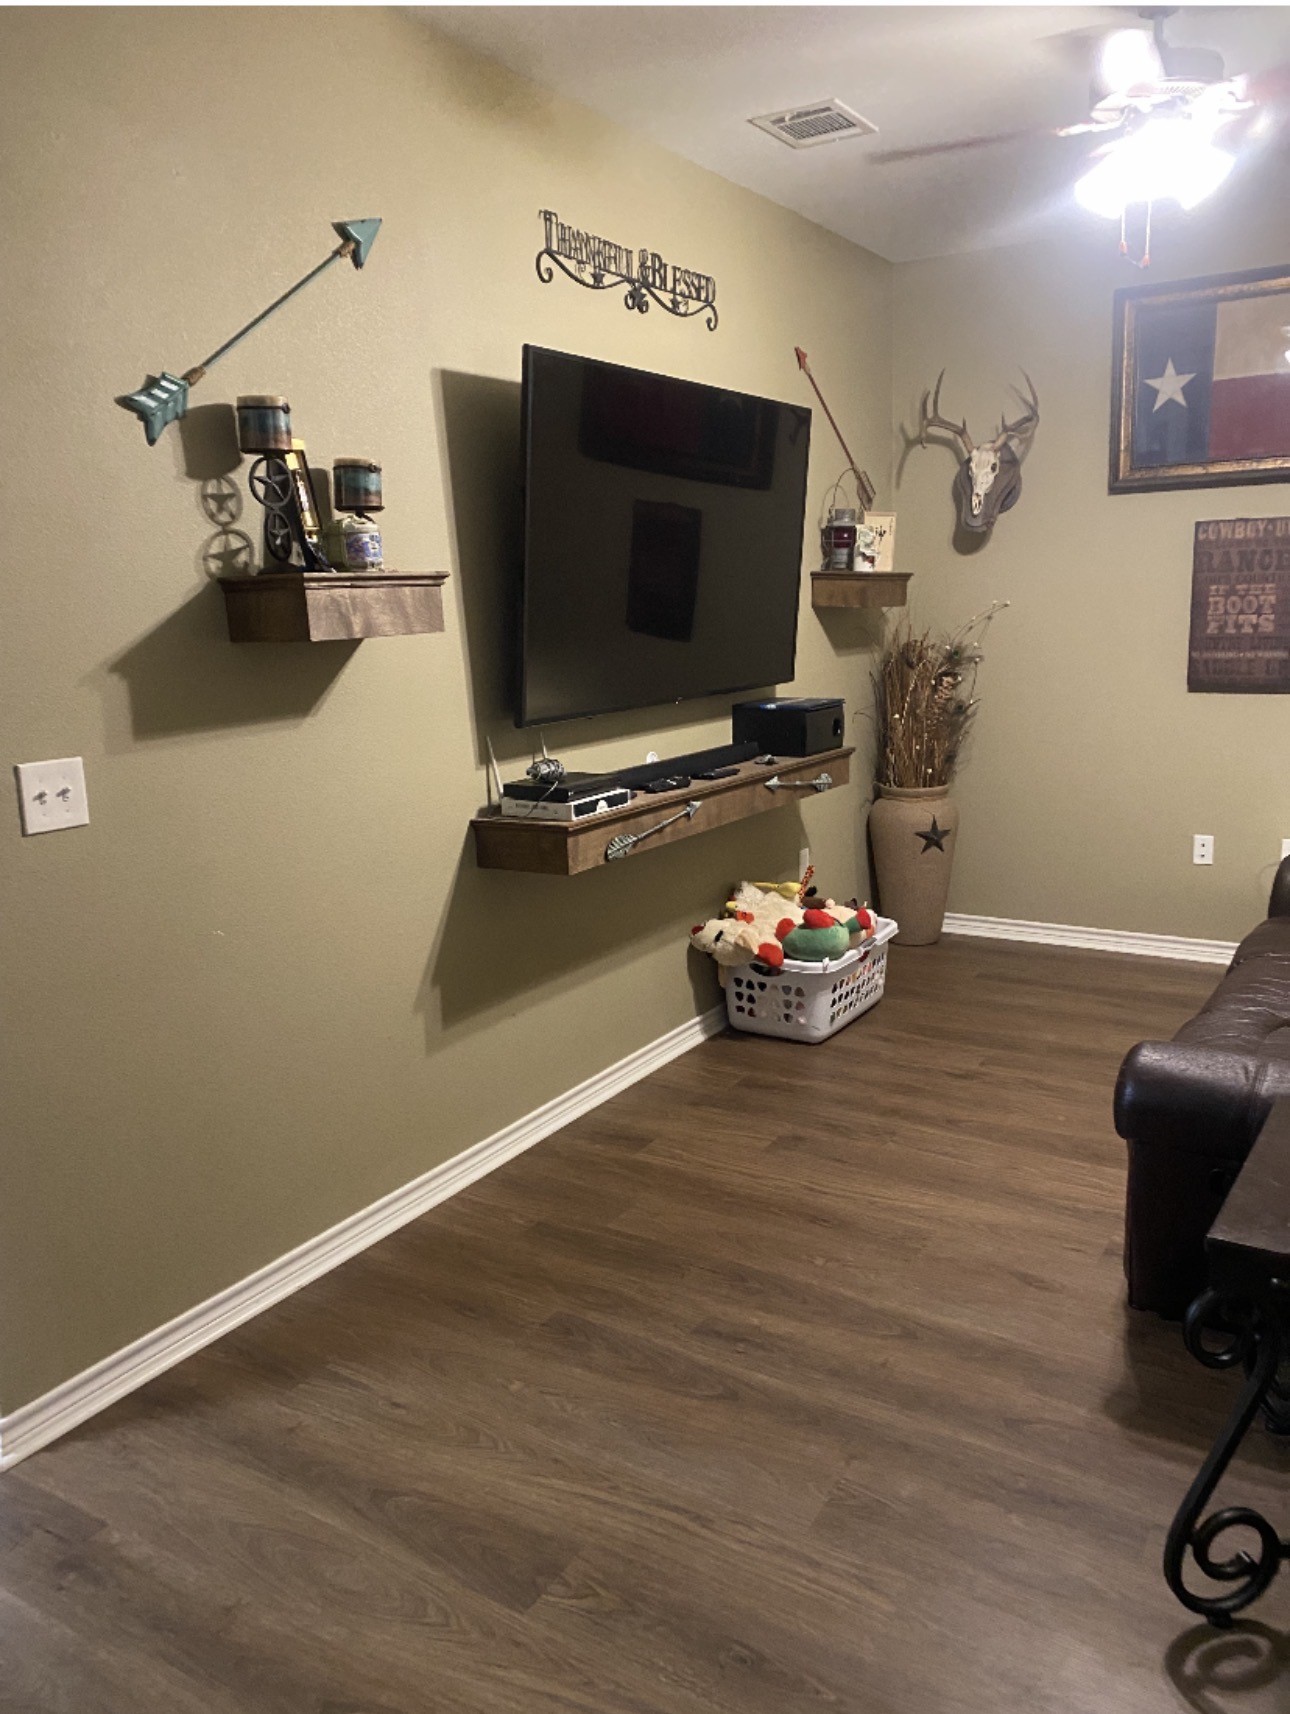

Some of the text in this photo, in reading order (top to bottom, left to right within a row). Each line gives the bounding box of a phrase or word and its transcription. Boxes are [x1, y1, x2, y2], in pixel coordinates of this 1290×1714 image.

[650, 252, 716, 304] BLESSED
[1198, 519, 1290, 541] COWBOY U
[1207, 595, 1277, 614] BOOT
[1206, 614, 1275, 634] FITS
